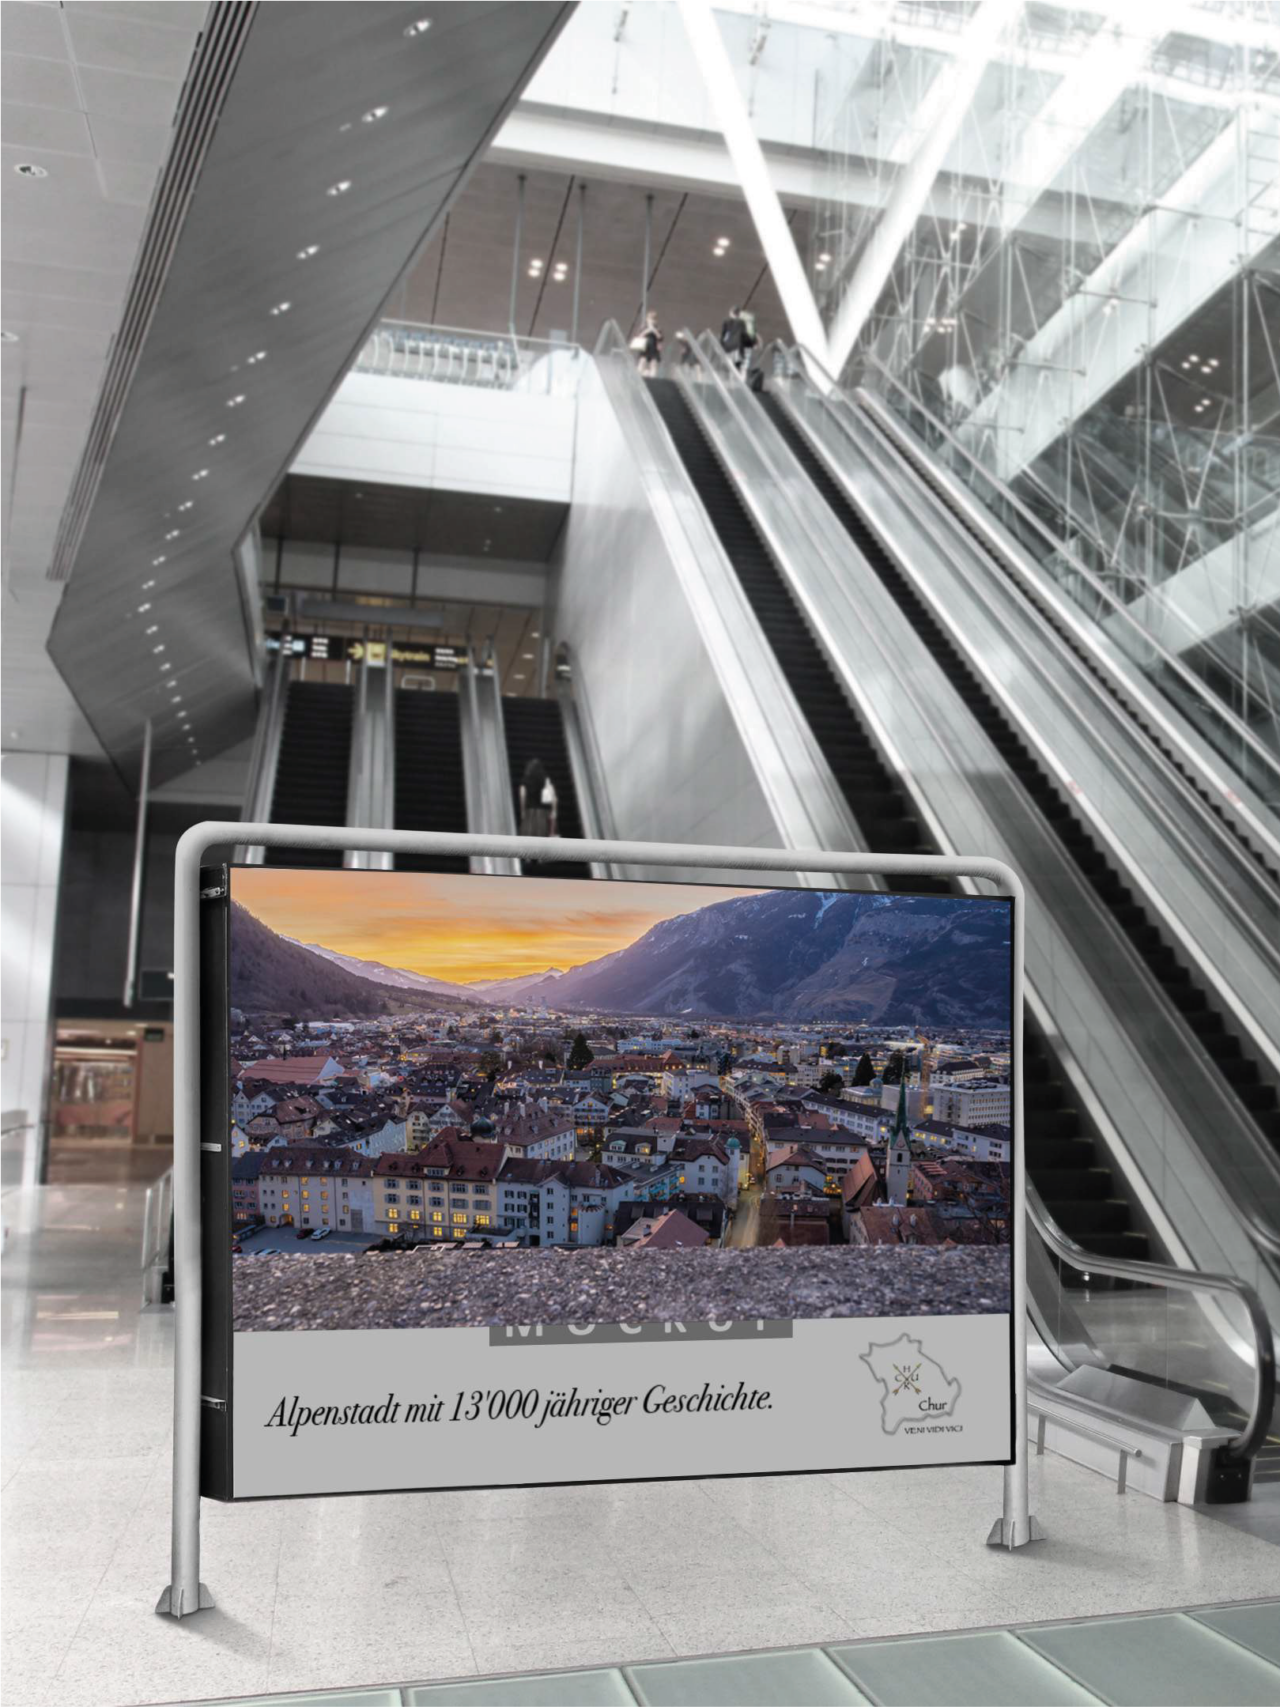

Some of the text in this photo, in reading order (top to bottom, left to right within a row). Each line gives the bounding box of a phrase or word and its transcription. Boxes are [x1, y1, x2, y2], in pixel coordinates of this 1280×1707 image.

[264, 1382, 773, 1437] Alpenstadt mit 13'000 jähriger Geschichte.
[918, 1396, 947, 1412] Chur
[904, 1424, 963, 1435] VENI VIDI VICI
